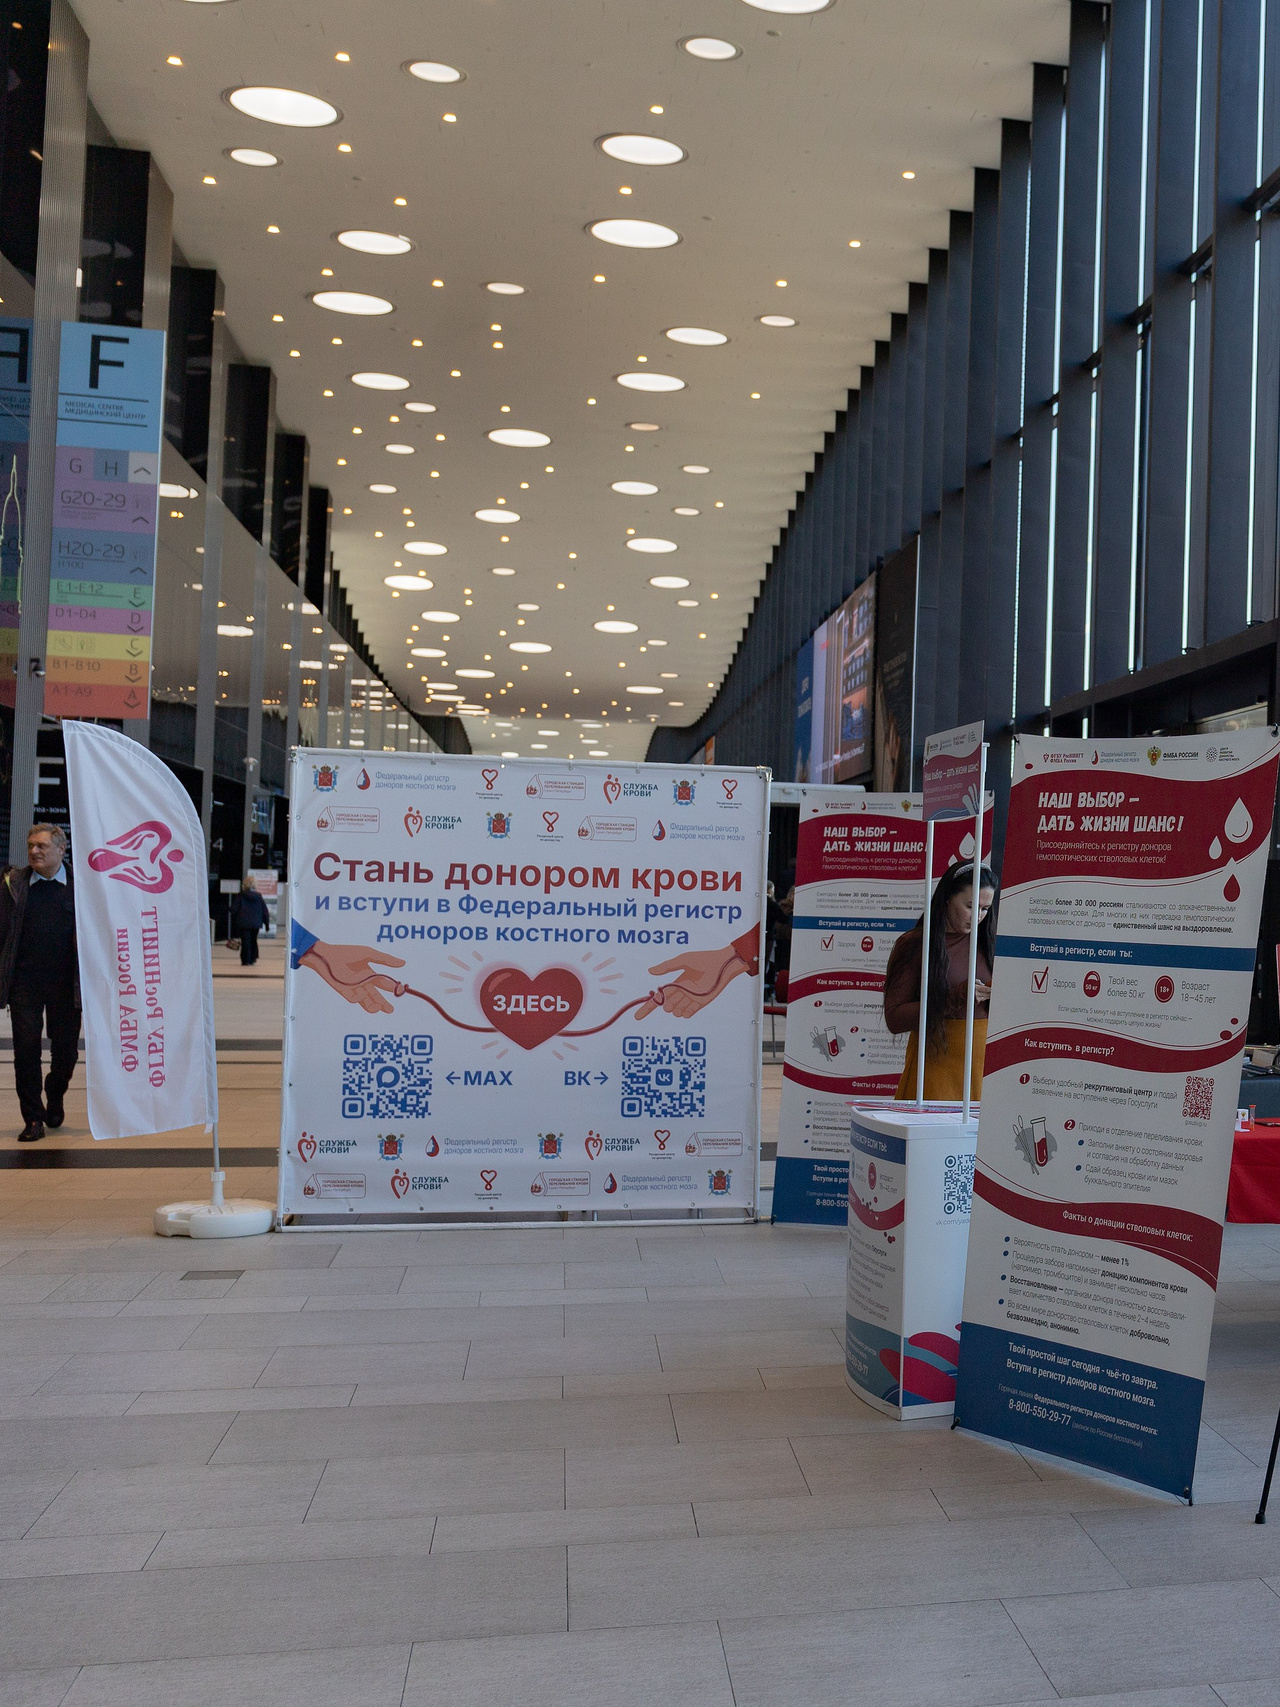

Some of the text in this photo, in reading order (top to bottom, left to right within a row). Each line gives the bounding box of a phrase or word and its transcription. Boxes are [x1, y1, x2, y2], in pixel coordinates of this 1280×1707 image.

[89, 334, 129, 389] F
[65, 408, 121, 418] МЕДИЦИНСКИЙ
[70, 458, 82, 473] G
[105, 460, 117, 476] H
[61, 490, 125, 507] G20-29
[59, 541, 125, 559] H20-29
[134, 588, 140, 598] E
[56, 608, 96, 619] D1-D4
[131, 613, 140, 623] D
[130, 639, 138, 650] C
[53, 661, 100, 671] B1-B10
[130, 664, 138, 675] B
[52, 682, 91, 696] A1-A9
[128, 689, 137, 700] A
[376, 771, 449, 782] Федеральный регистр
[624, 783, 658, 791] СЛУЖБА
[1038, 792, 1125, 808] НАШ ВЫБОР
[425, 815, 462, 823] СЛУЖБА
[1038, 816, 1184, 834] ДАТЬ ЖИЗНИ ШАНС!
[824, 827, 886, 837] НАШ ВЫБОР
[823, 842, 850, 852] ДАТЬ
[855, 842, 890, 852] ЖИЗНИ
[1037, 840, 1100, 851] Присоединяйтесь
[1108, 842, 1139, 852] регистру
[1141, 843, 1171, 852] доноров
[313, 851, 434, 884] Стань
[445, 858, 619, 893] донором
[632, 867, 742, 897] крови
[316, 894, 742, 924] и вступи в Федеральный регистр
[376, 924, 689, 944] доноров костного мозга
[1030, 943, 1132, 958] Вступай в регистр, если ты:
[1053, 979, 1076, 989] Здоров
[1109, 976, 1138, 987] Твой вес
[1182, 981, 1210, 991] Возраст
[1108, 988, 1145, 999] более 50 кг
[493, 994, 570, 1014] ЗДЕСЬ
[1204, 996, 1216, 1004] лет
[464, 1071, 513, 1086] MAX
[564, 1071, 591, 1085] ВК
[935, 1218, 969, 1226] vk.com/yad
[1062, 1210, 1086, 1223] Факты
[1094, 1216, 1124, 1230] донации
[1127, 1222, 1165, 1237] стволовых
[1167, 1229, 1193, 1242] клеток:
[1009, 1399, 1071, 1426] 8-800-550-29-77
